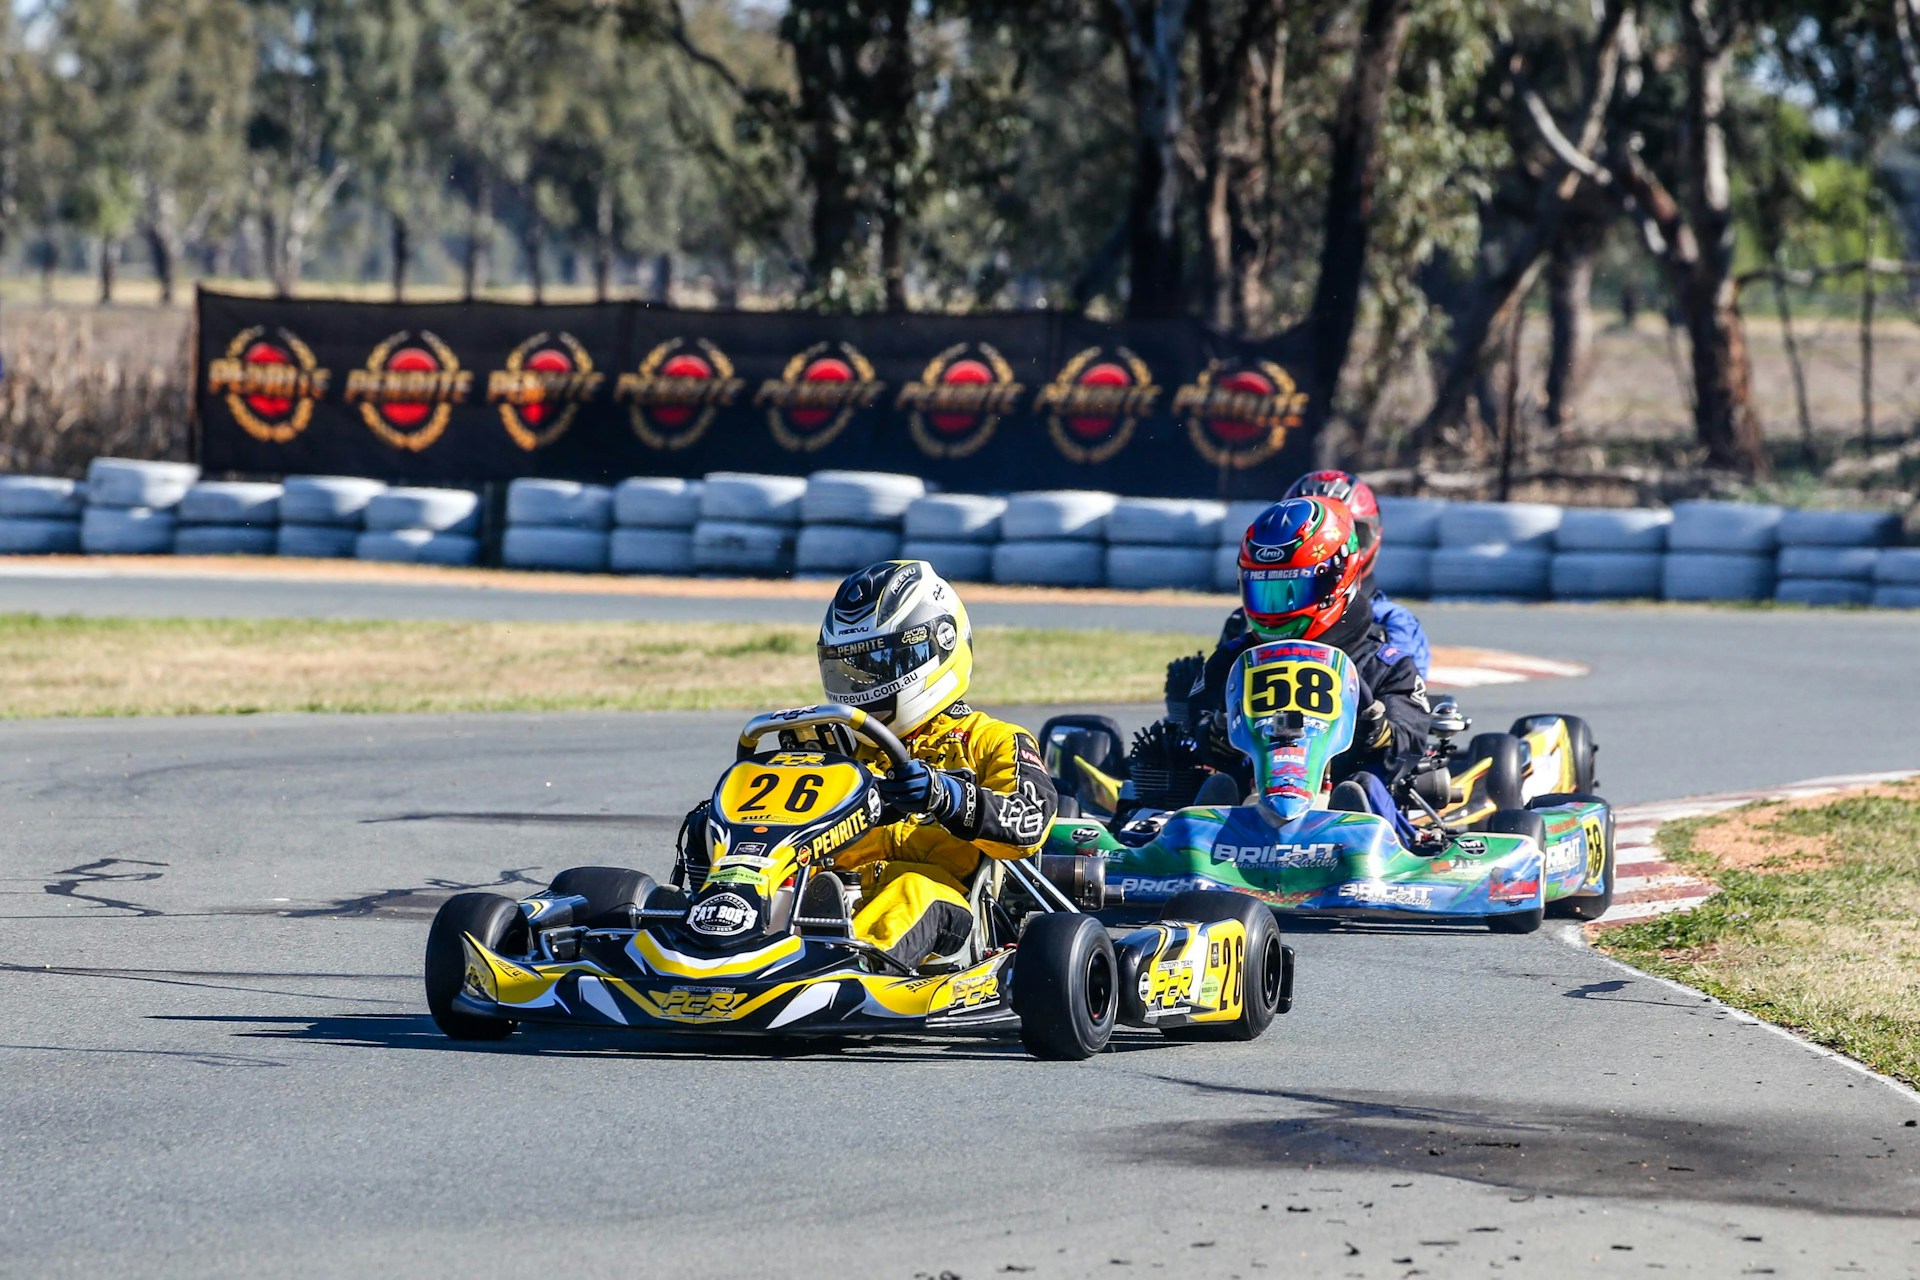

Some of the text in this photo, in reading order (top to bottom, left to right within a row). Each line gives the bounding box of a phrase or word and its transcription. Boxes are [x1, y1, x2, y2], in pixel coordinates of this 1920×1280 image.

[208, 357, 331, 400] PENRITE
[345, 368, 475, 405] PENRITE
[1260, 548, 1281, 558] Arai
[890, 567, 917, 596] REEVU
[1250, 569, 1299, 580] PACE IMAGES
[838, 626, 870, 636] REEVU
[837, 638, 885, 658] PENRITE
[1259, 647, 1327, 660] ZANE
[1251, 666, 1334, 715] 58
[766, 754, 826, 767] PCR
[737, 773, 824, 813] 26
[963, 782, 977, 828] sparco
[812, 807, 869, 860] PENRITE
[1214, 844, 1336, 864] BRIGHT
[1287, 852, 1340, 872] Racing
[1121, 878, 1217, 892] BRIGHT
[1338, 883, 1433, 900] BRIGHT
[686, 905, 759, 930] FAT BOB'S
[1220, 935, 1243, 1011] 26
[949, 978, 1000, 1008] PCR
[1149, 967, 1194, 1008] PCR
[660, 991, 735, 1014] PCR
